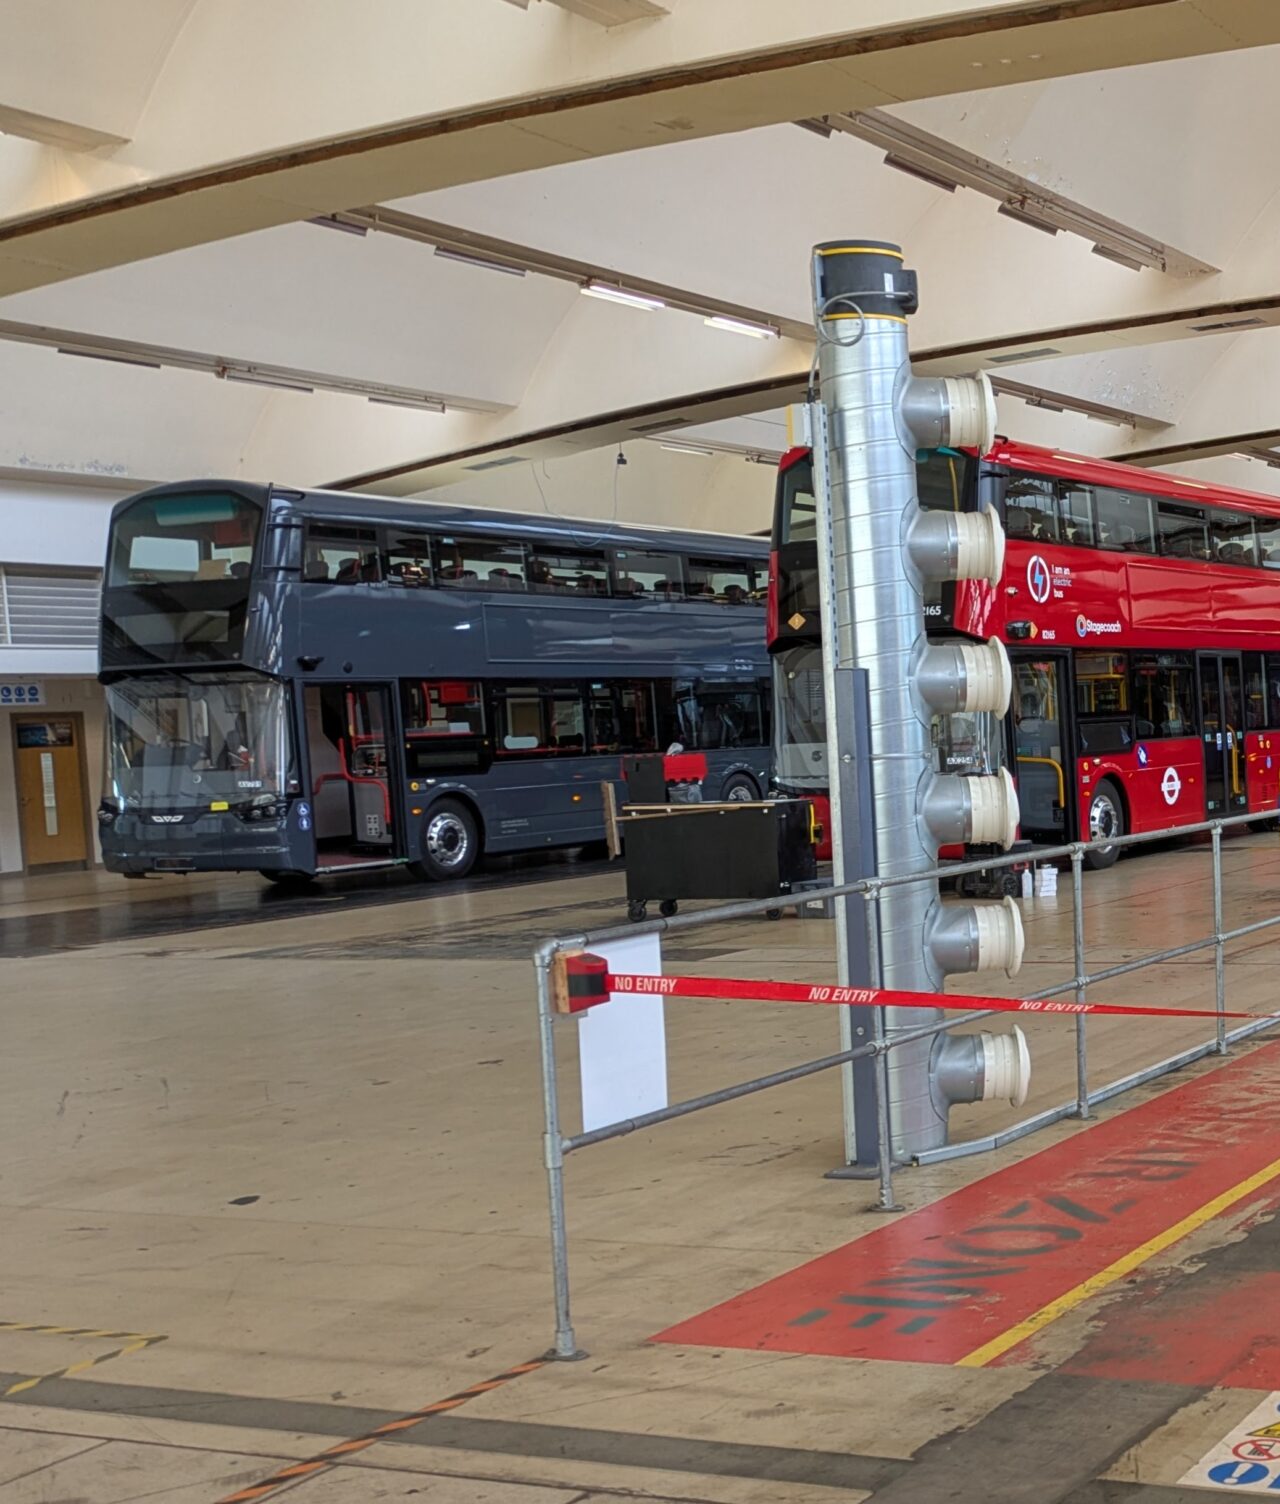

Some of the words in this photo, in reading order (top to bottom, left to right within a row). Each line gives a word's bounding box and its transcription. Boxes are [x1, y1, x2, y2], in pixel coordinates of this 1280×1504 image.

[1086, 619, 1122, 635] Stagecoach
[614, 977, 633, 990] NO
[636, 977, 677, 993] ENTRY
[808, 987, 830, 1001] NO
[831, 989, 879, 1003] ENTRY
[1018, 1000, 1043, 1010] NO
[1043, 1002, 1095, 1012] ENTRY
